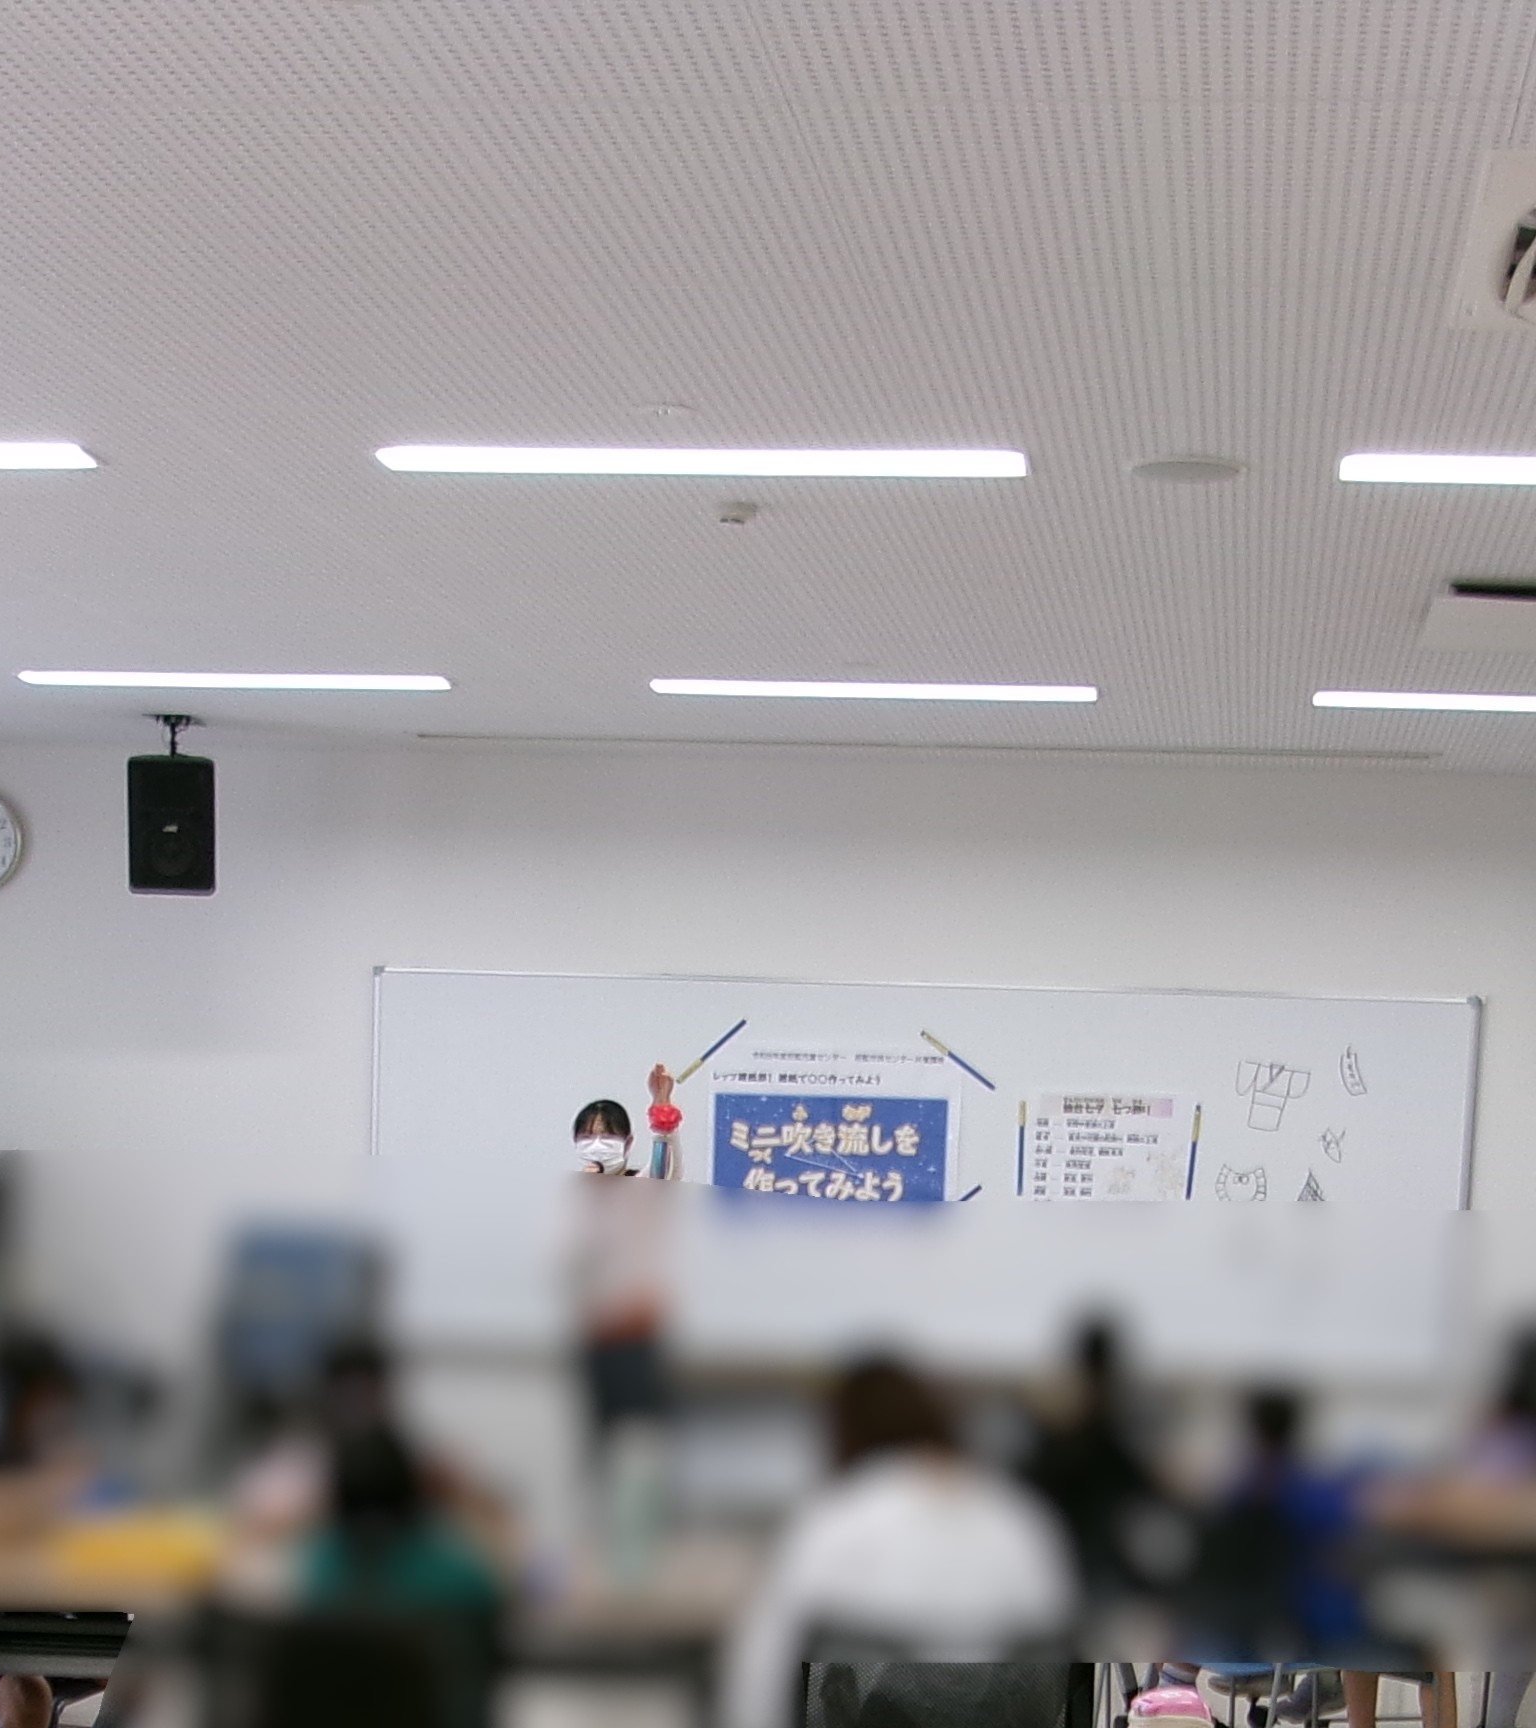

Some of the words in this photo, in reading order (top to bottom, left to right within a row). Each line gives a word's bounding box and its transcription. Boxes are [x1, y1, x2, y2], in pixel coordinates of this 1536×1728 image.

[730, 1121, 919, 1156] ミニ吹き流しを
[744, 1168, 904, 1201] 作ってみよう
